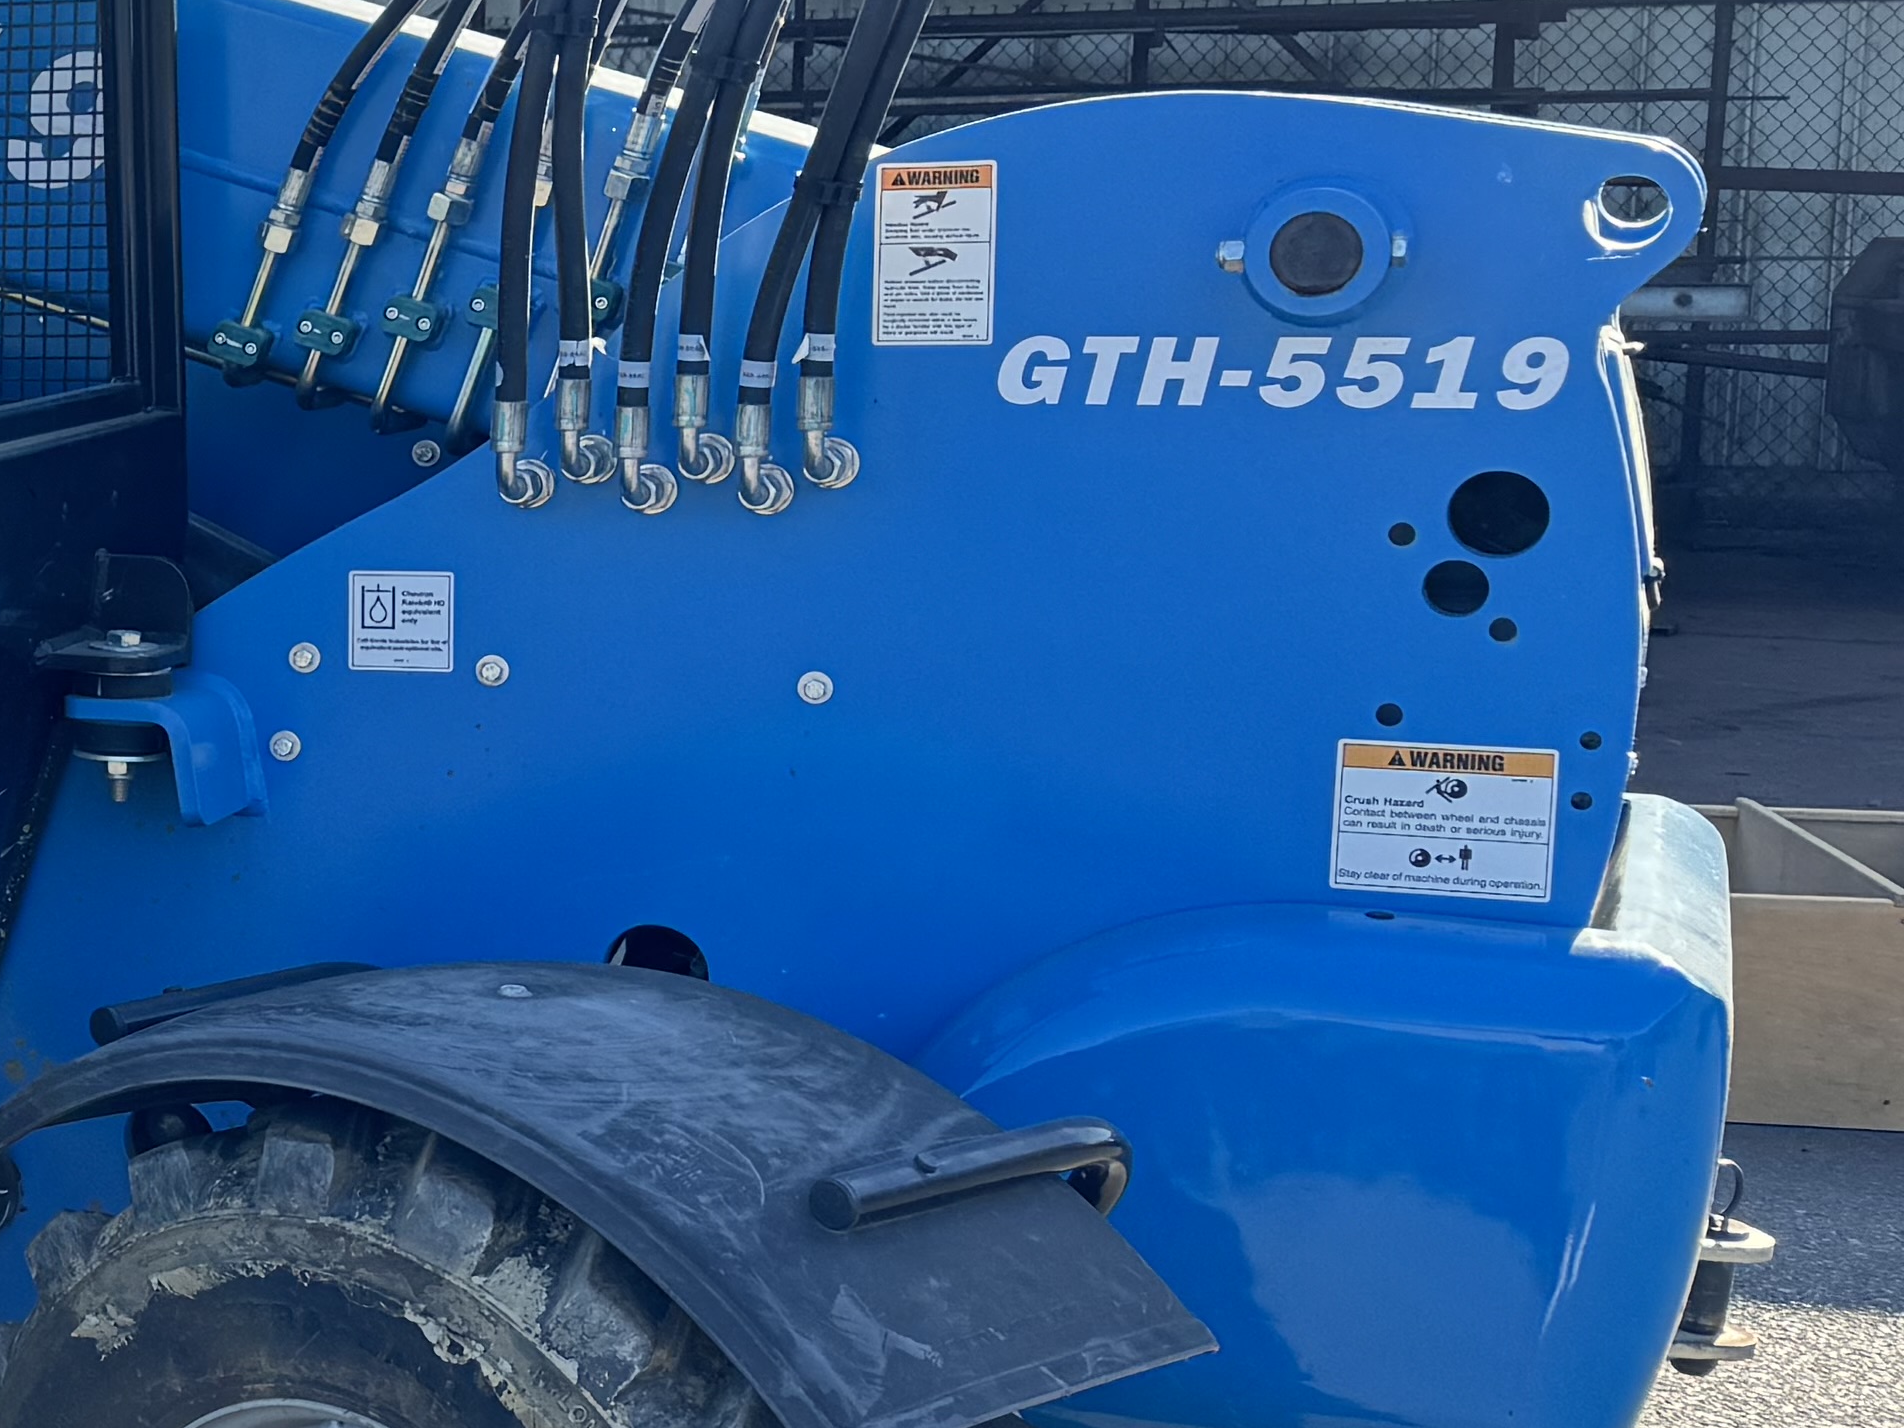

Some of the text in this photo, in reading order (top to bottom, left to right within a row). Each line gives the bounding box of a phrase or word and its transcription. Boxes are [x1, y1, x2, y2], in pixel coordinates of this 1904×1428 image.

[907, 169, 980, 186] WARNING
[996, 335, 1571, 411] GTH-5519
[1409, 750, 1505, 772] WARNING
[1344, 794, 1425, 808] Crush Hazard
[1343, 806, 1546, 827] Contact between wheel and chassis
[1342, 819, 1362, 828] can
[1366, 819, 1397, 830] result
[1401, 821, 1411, 831] in
[1414, 822, 1446, 833] death
[1450, 825, 1462, 834] or
[1466, 826, 1507, 837] serious
[1337, 867, 1362, 881] Stay
[1363, 869, 1390, 881] clear
[1392, 871, 1404, 882] of
[1404, 873, 1450, 885] machine
[1452, 875, 1487, 889] during
